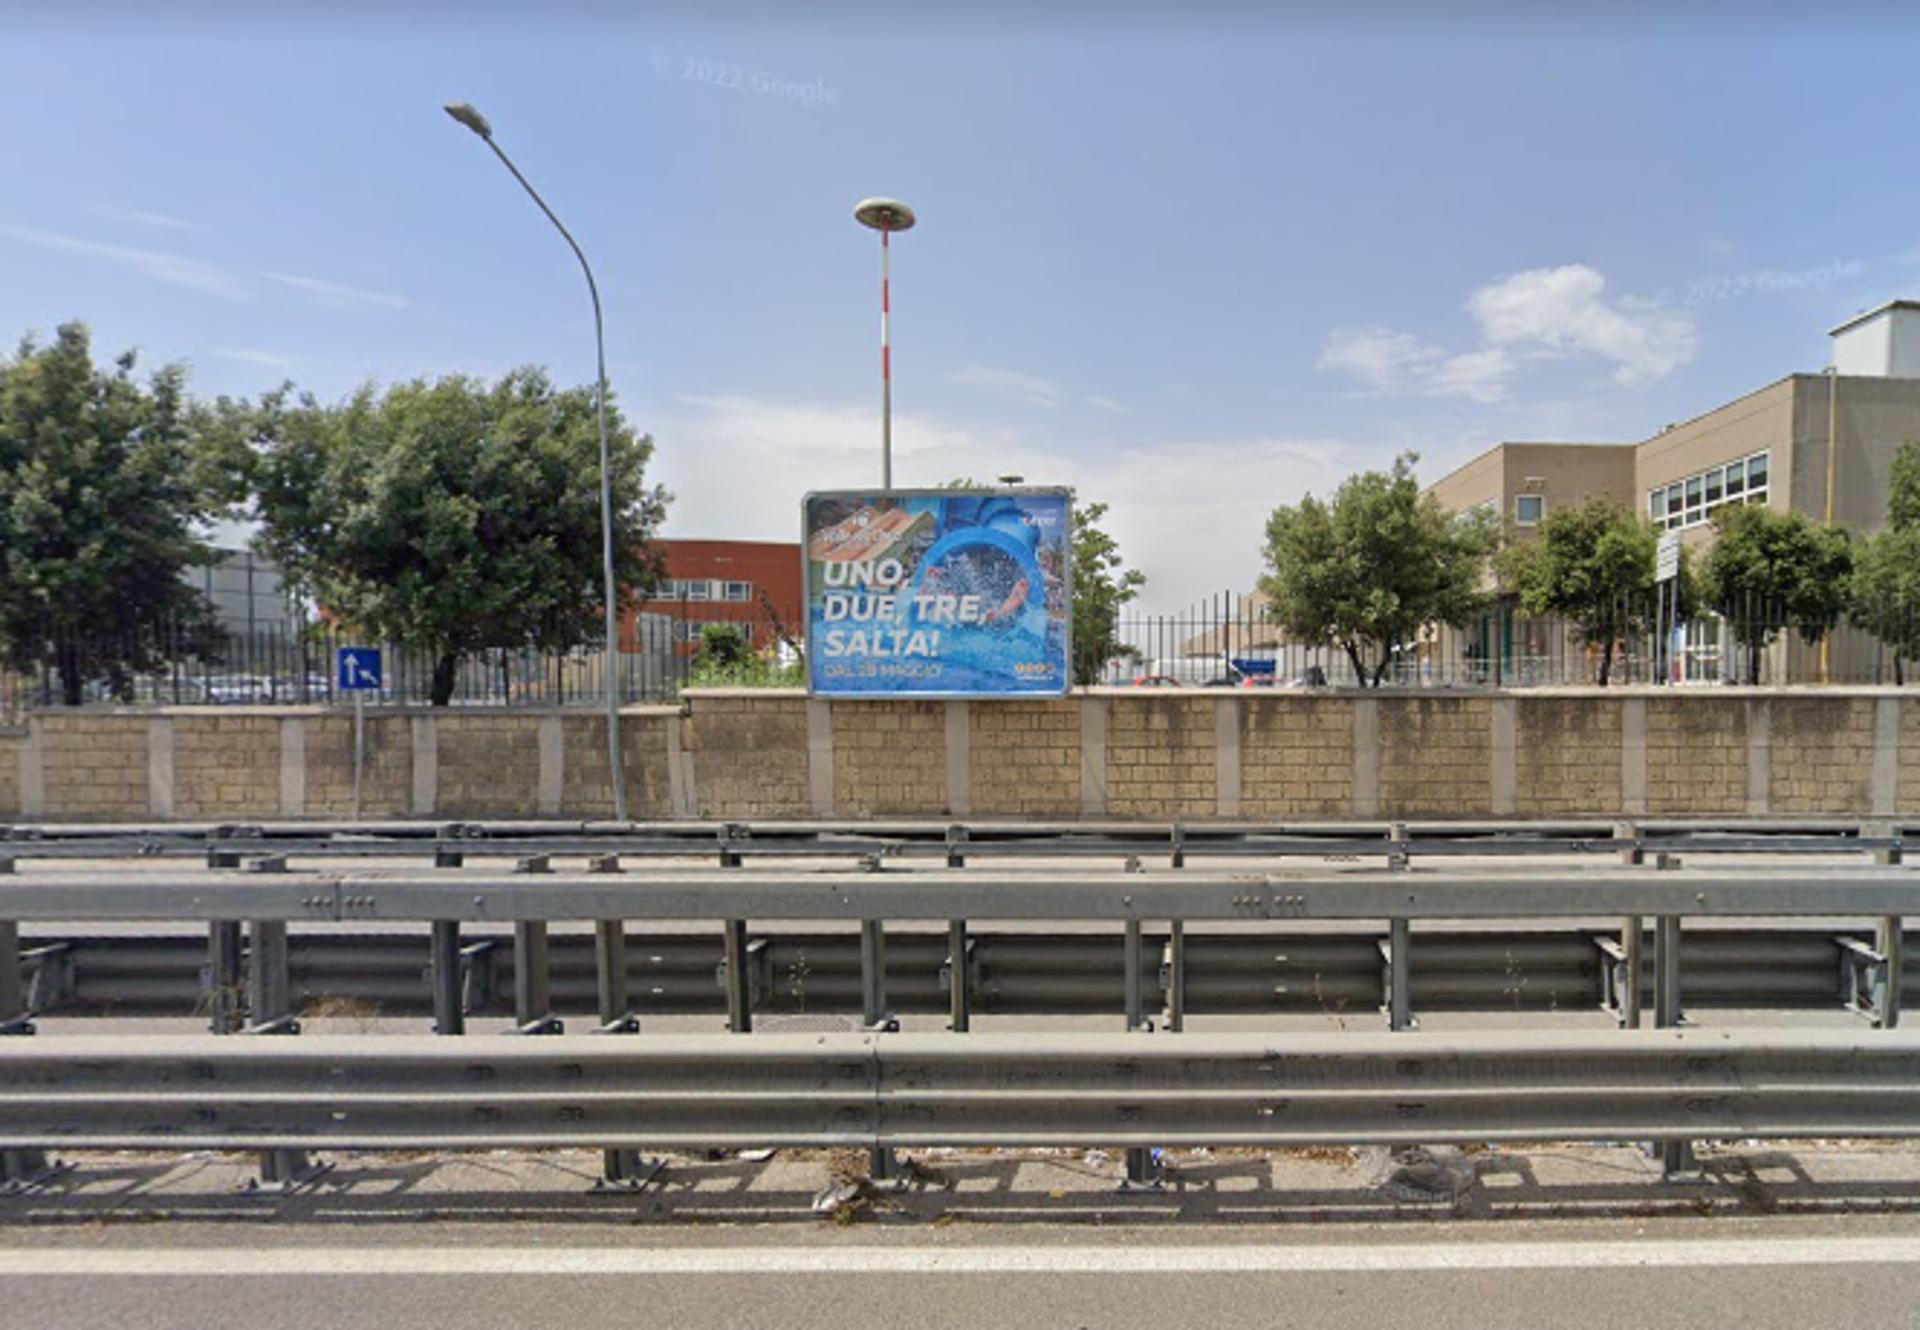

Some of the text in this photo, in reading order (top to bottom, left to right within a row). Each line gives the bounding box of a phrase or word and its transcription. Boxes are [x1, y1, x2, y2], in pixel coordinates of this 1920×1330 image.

[823, 559, 912, 591] UNO,
[824, 594, 986, 626] DUE, TRE,
[823, 629, 941, 657] SALTA!
